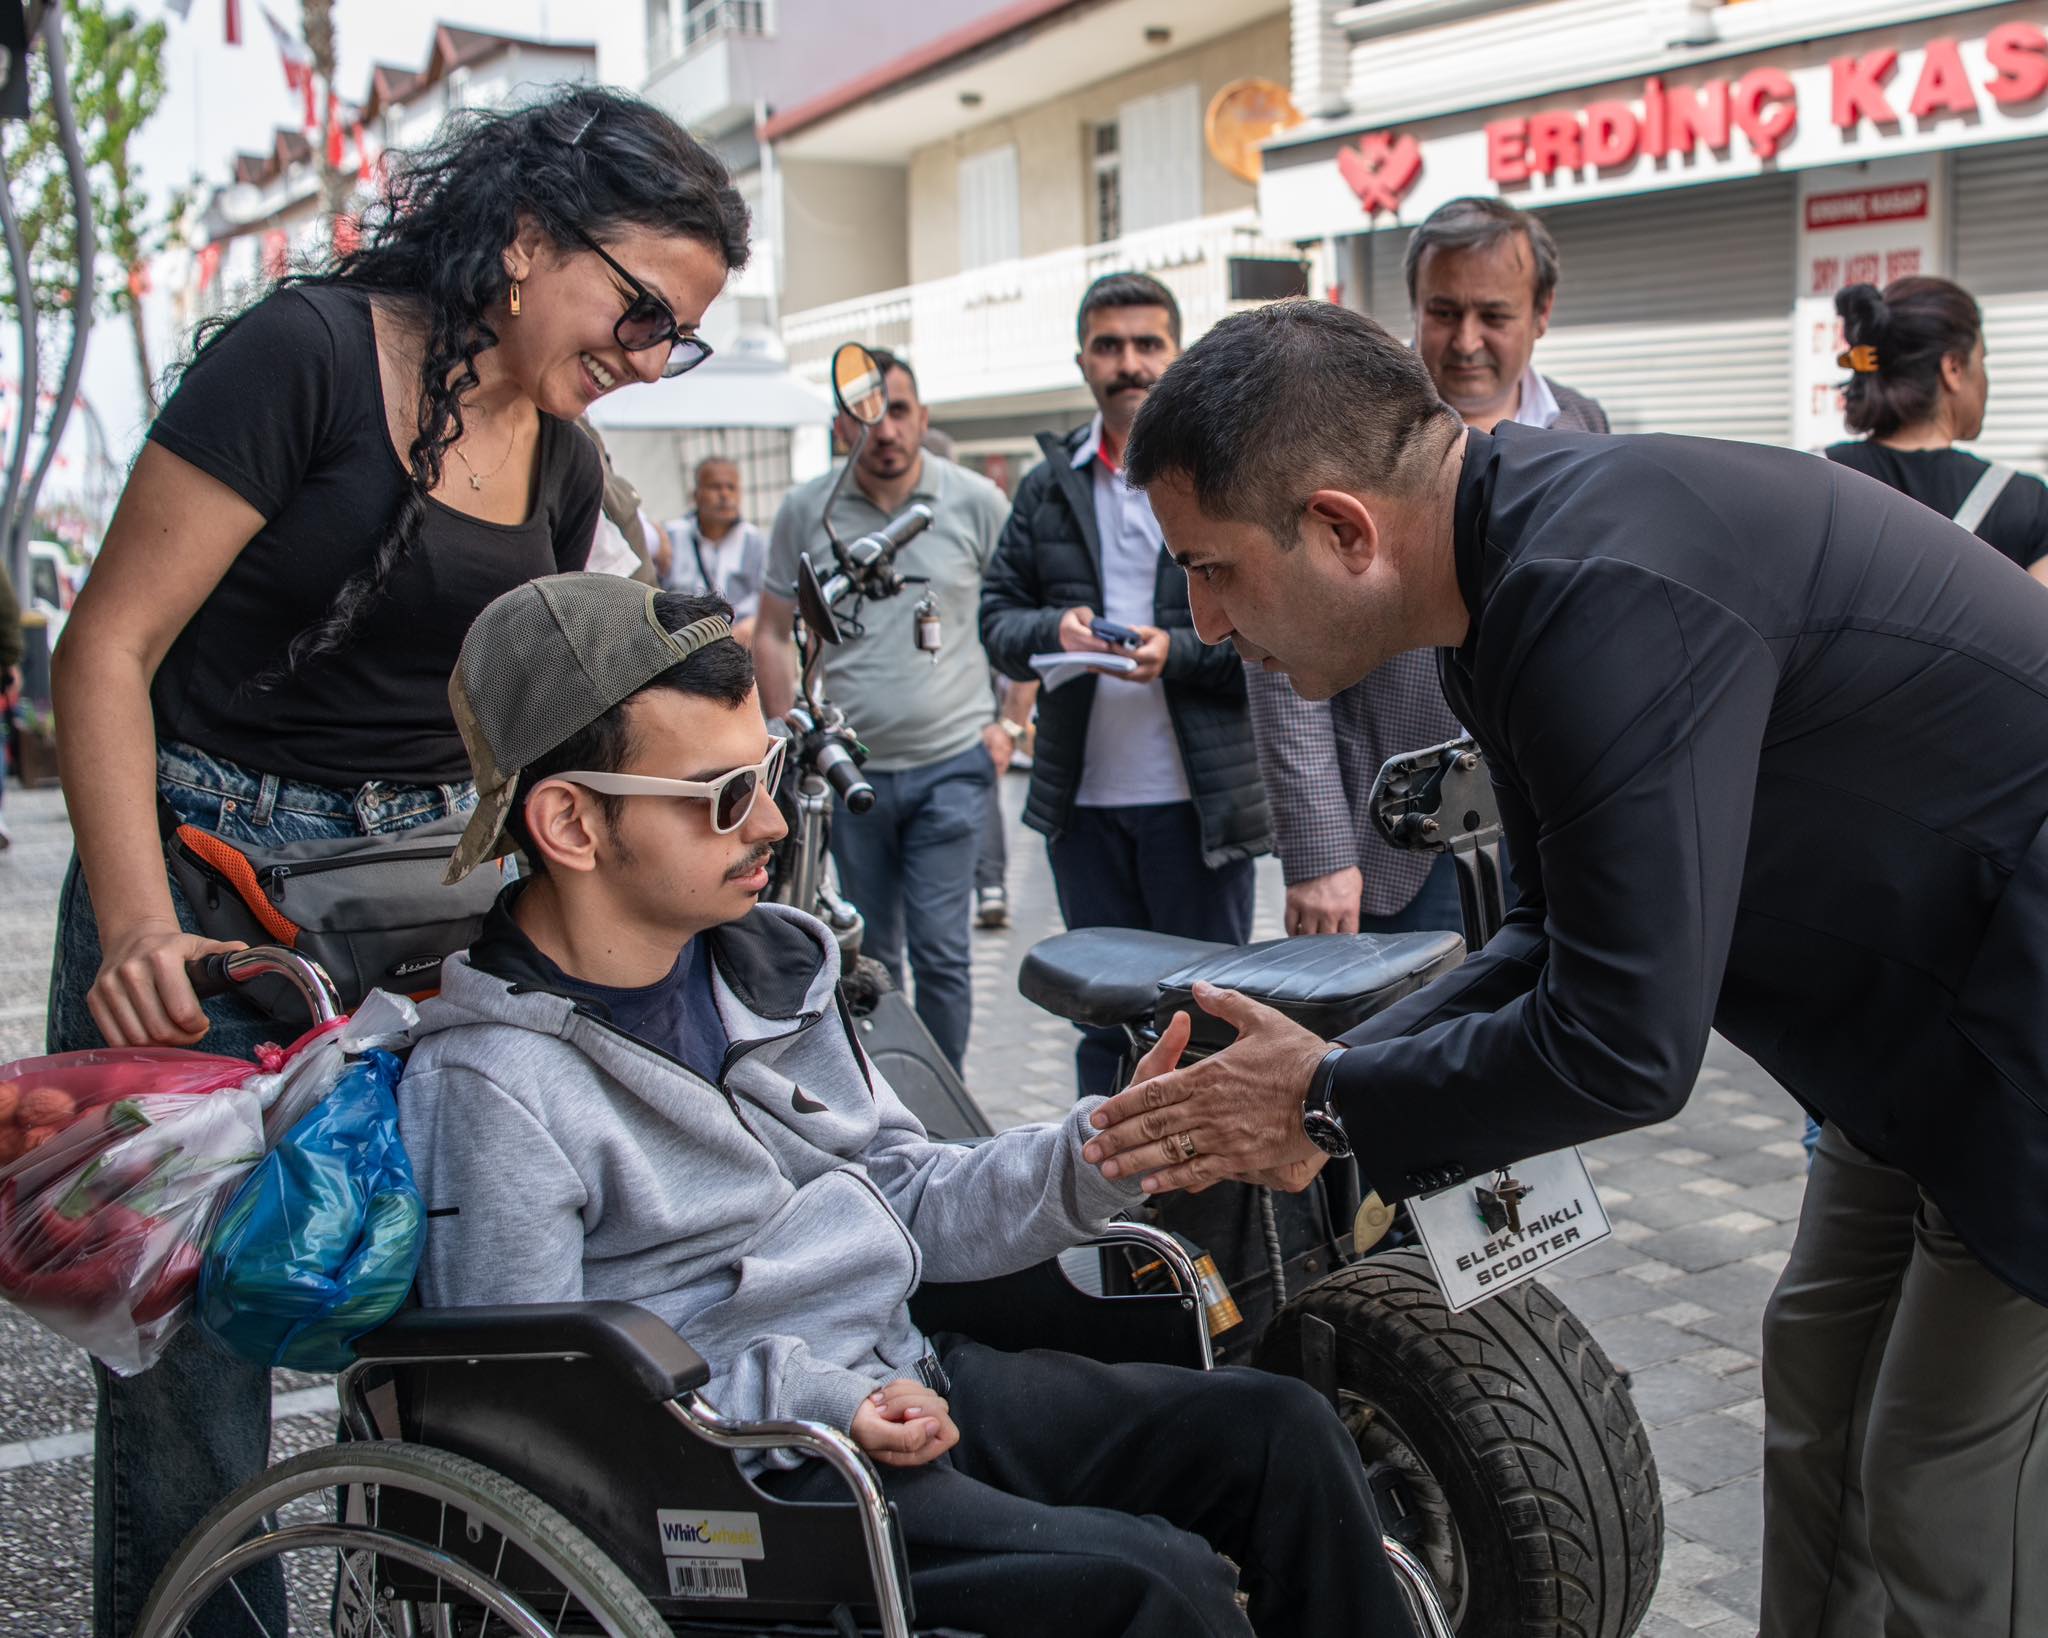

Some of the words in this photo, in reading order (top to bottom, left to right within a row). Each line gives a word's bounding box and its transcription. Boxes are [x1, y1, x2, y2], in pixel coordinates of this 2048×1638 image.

[1484, 67, 1797, 181] ERDİNÇ
[1829, 20, 2048, 128] KAS
[1456, 1198, 1583, 1271] ELEKTRİKLİ
[1476, 1227, 1580, 1286] SCOOTER
